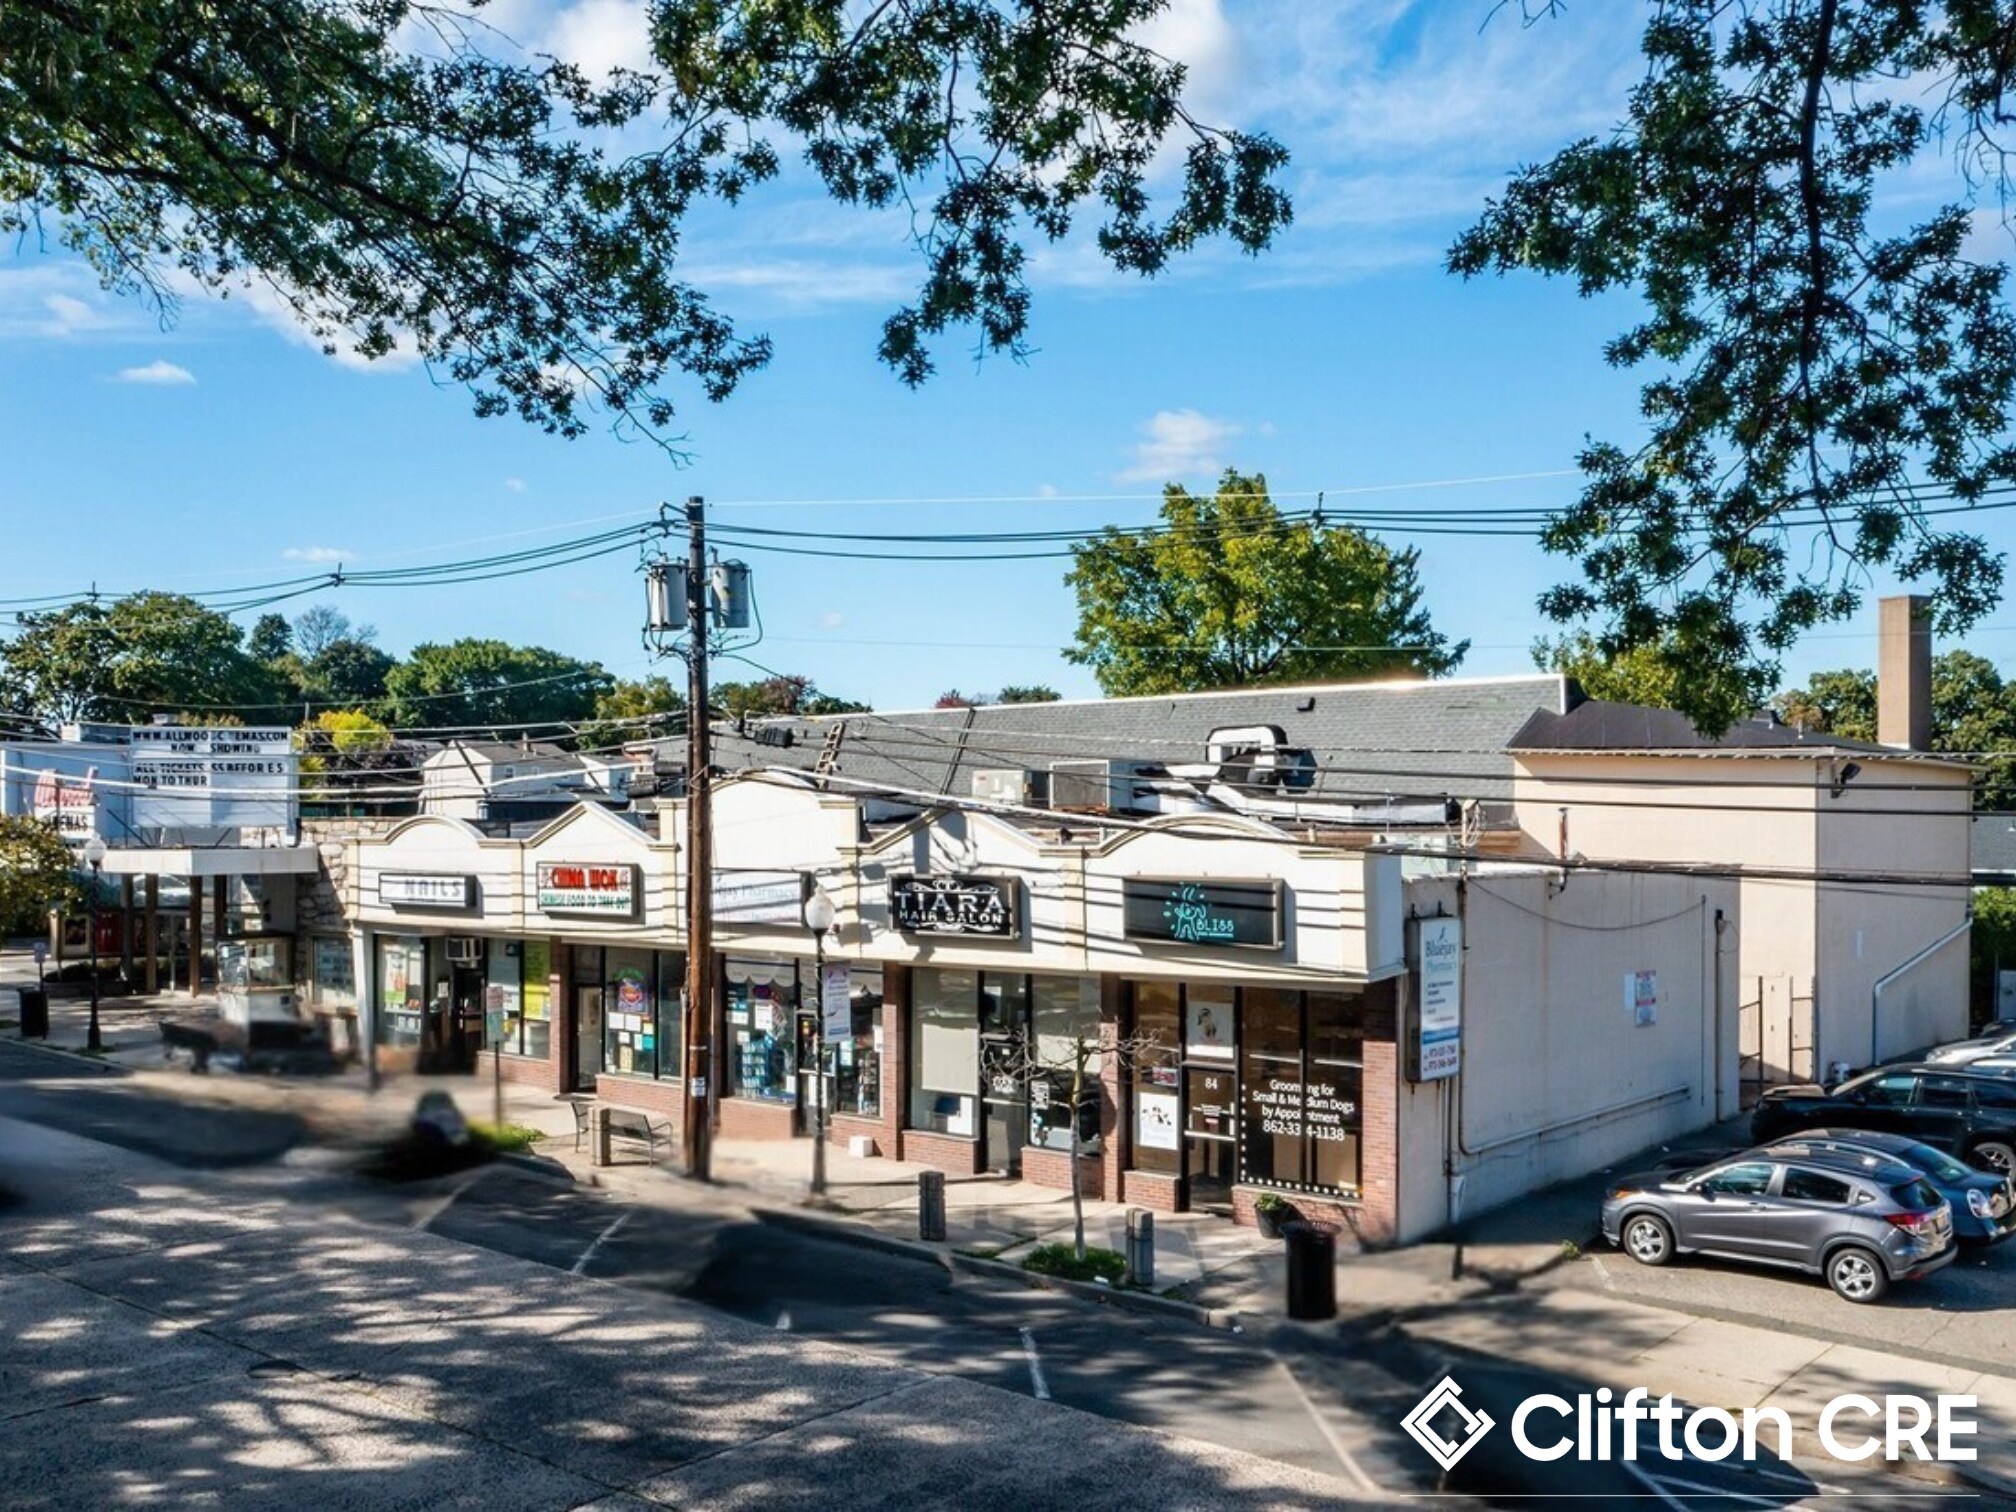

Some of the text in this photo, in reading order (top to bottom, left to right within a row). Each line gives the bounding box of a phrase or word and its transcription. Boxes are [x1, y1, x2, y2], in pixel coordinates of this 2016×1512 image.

[210, 743, 260, 753] SHOWING
[133, 775, 207, 786] MON TO THUR
[405, 878, 460, 896] NAILS
[893, 891, 1006, 913] TIARA
[899, 910, 1003, 924] HAIR SALON
[1196, 918, 1234, 932] BLISS
[1205, 1077, 1218, 1089] 84
[1320, 1083, 1335, 1096] for
[1252, 1090, 1277, 1103] Small
[1279, 1094, 1286, 1104] &
[1330, 1099, 1355, 1115] Dogs
[1261, 1104, 1274, 1119] by
